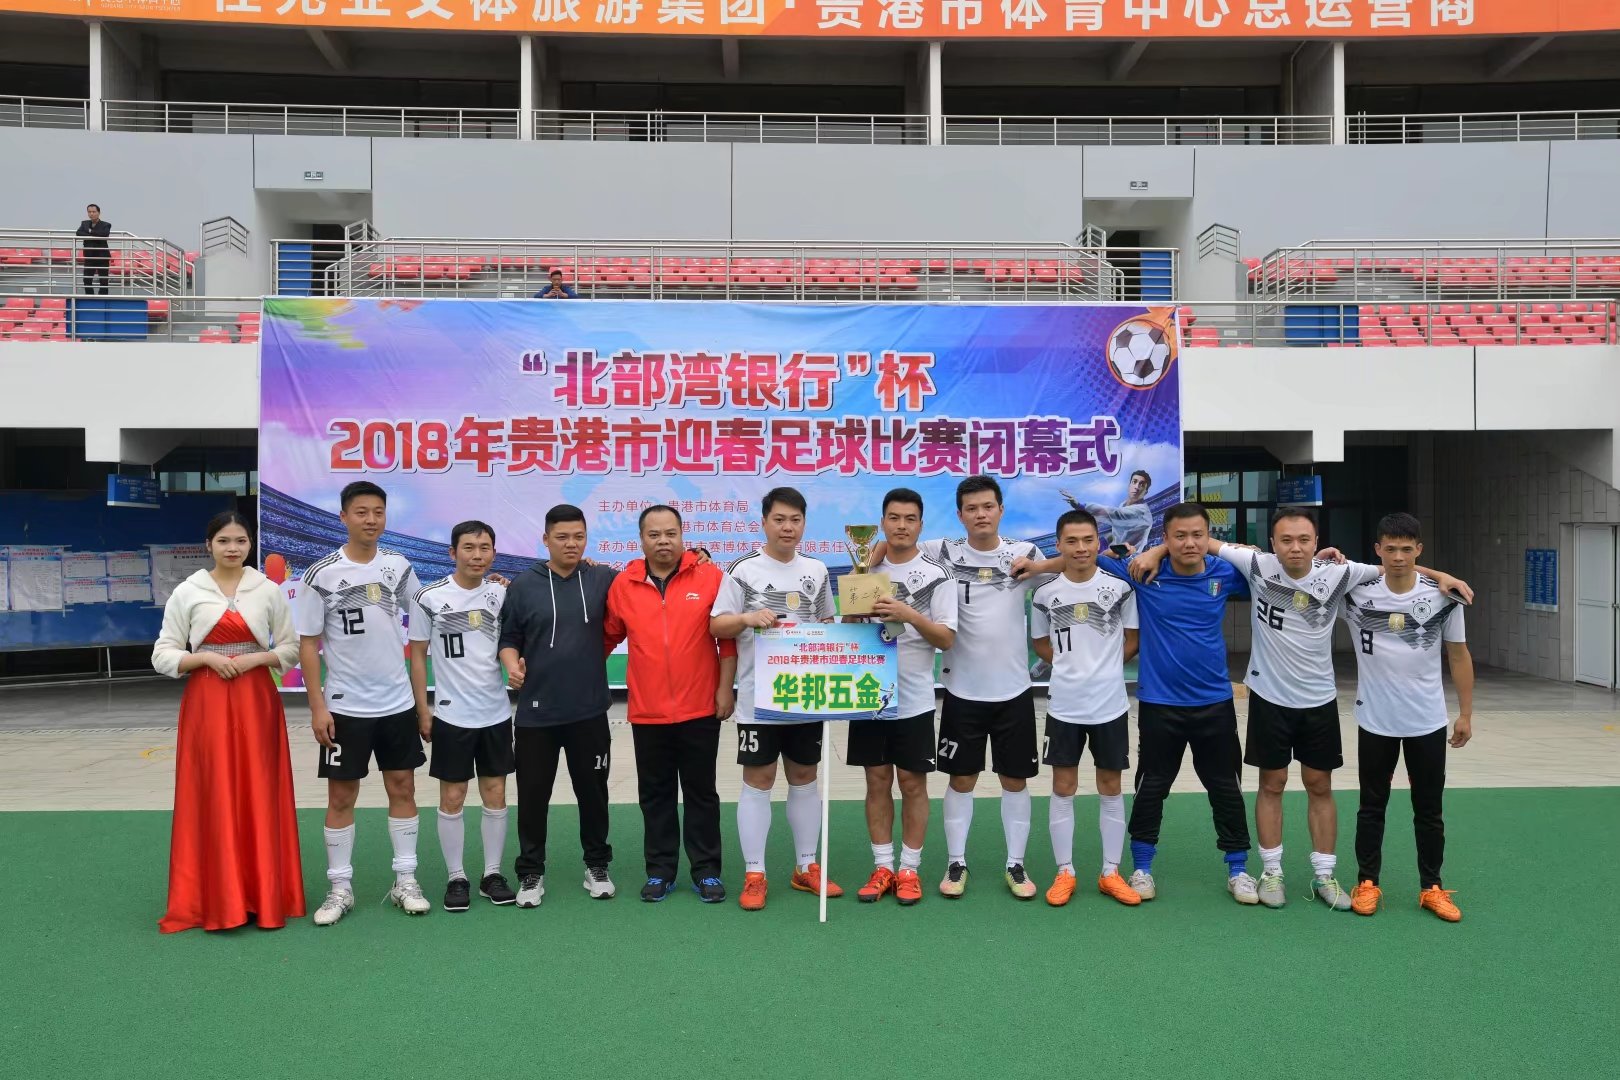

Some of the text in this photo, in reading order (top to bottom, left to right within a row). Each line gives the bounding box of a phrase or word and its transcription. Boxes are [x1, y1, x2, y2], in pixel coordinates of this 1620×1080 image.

[215, 0, 1475, 31] 体旅游集团·贵港市体育中心总运营商
[521, 351, 935, 408] “北部湾银行”杯
[330, 416, 1121, 474] 2018年贵港市迎春足球比赛闭幕式
[598, 541, 642, 552] 承办单
[338, 608, 365, 635] 12
[1257, 597, 1285, 631] 26
[440, 633, 465, 658] 10
[1055, 627, 1072, 654] 17
[1360, 629, 1374, 655] 8
[767, 655, 886, 665] 2018年贵港市迎春足球比赛
[772, 673, 881, 711] 华邦五金
[325, 742, 342, 766] 12
[739, 730, 759, 752] 25
[938, 738, 959, 759] 27
